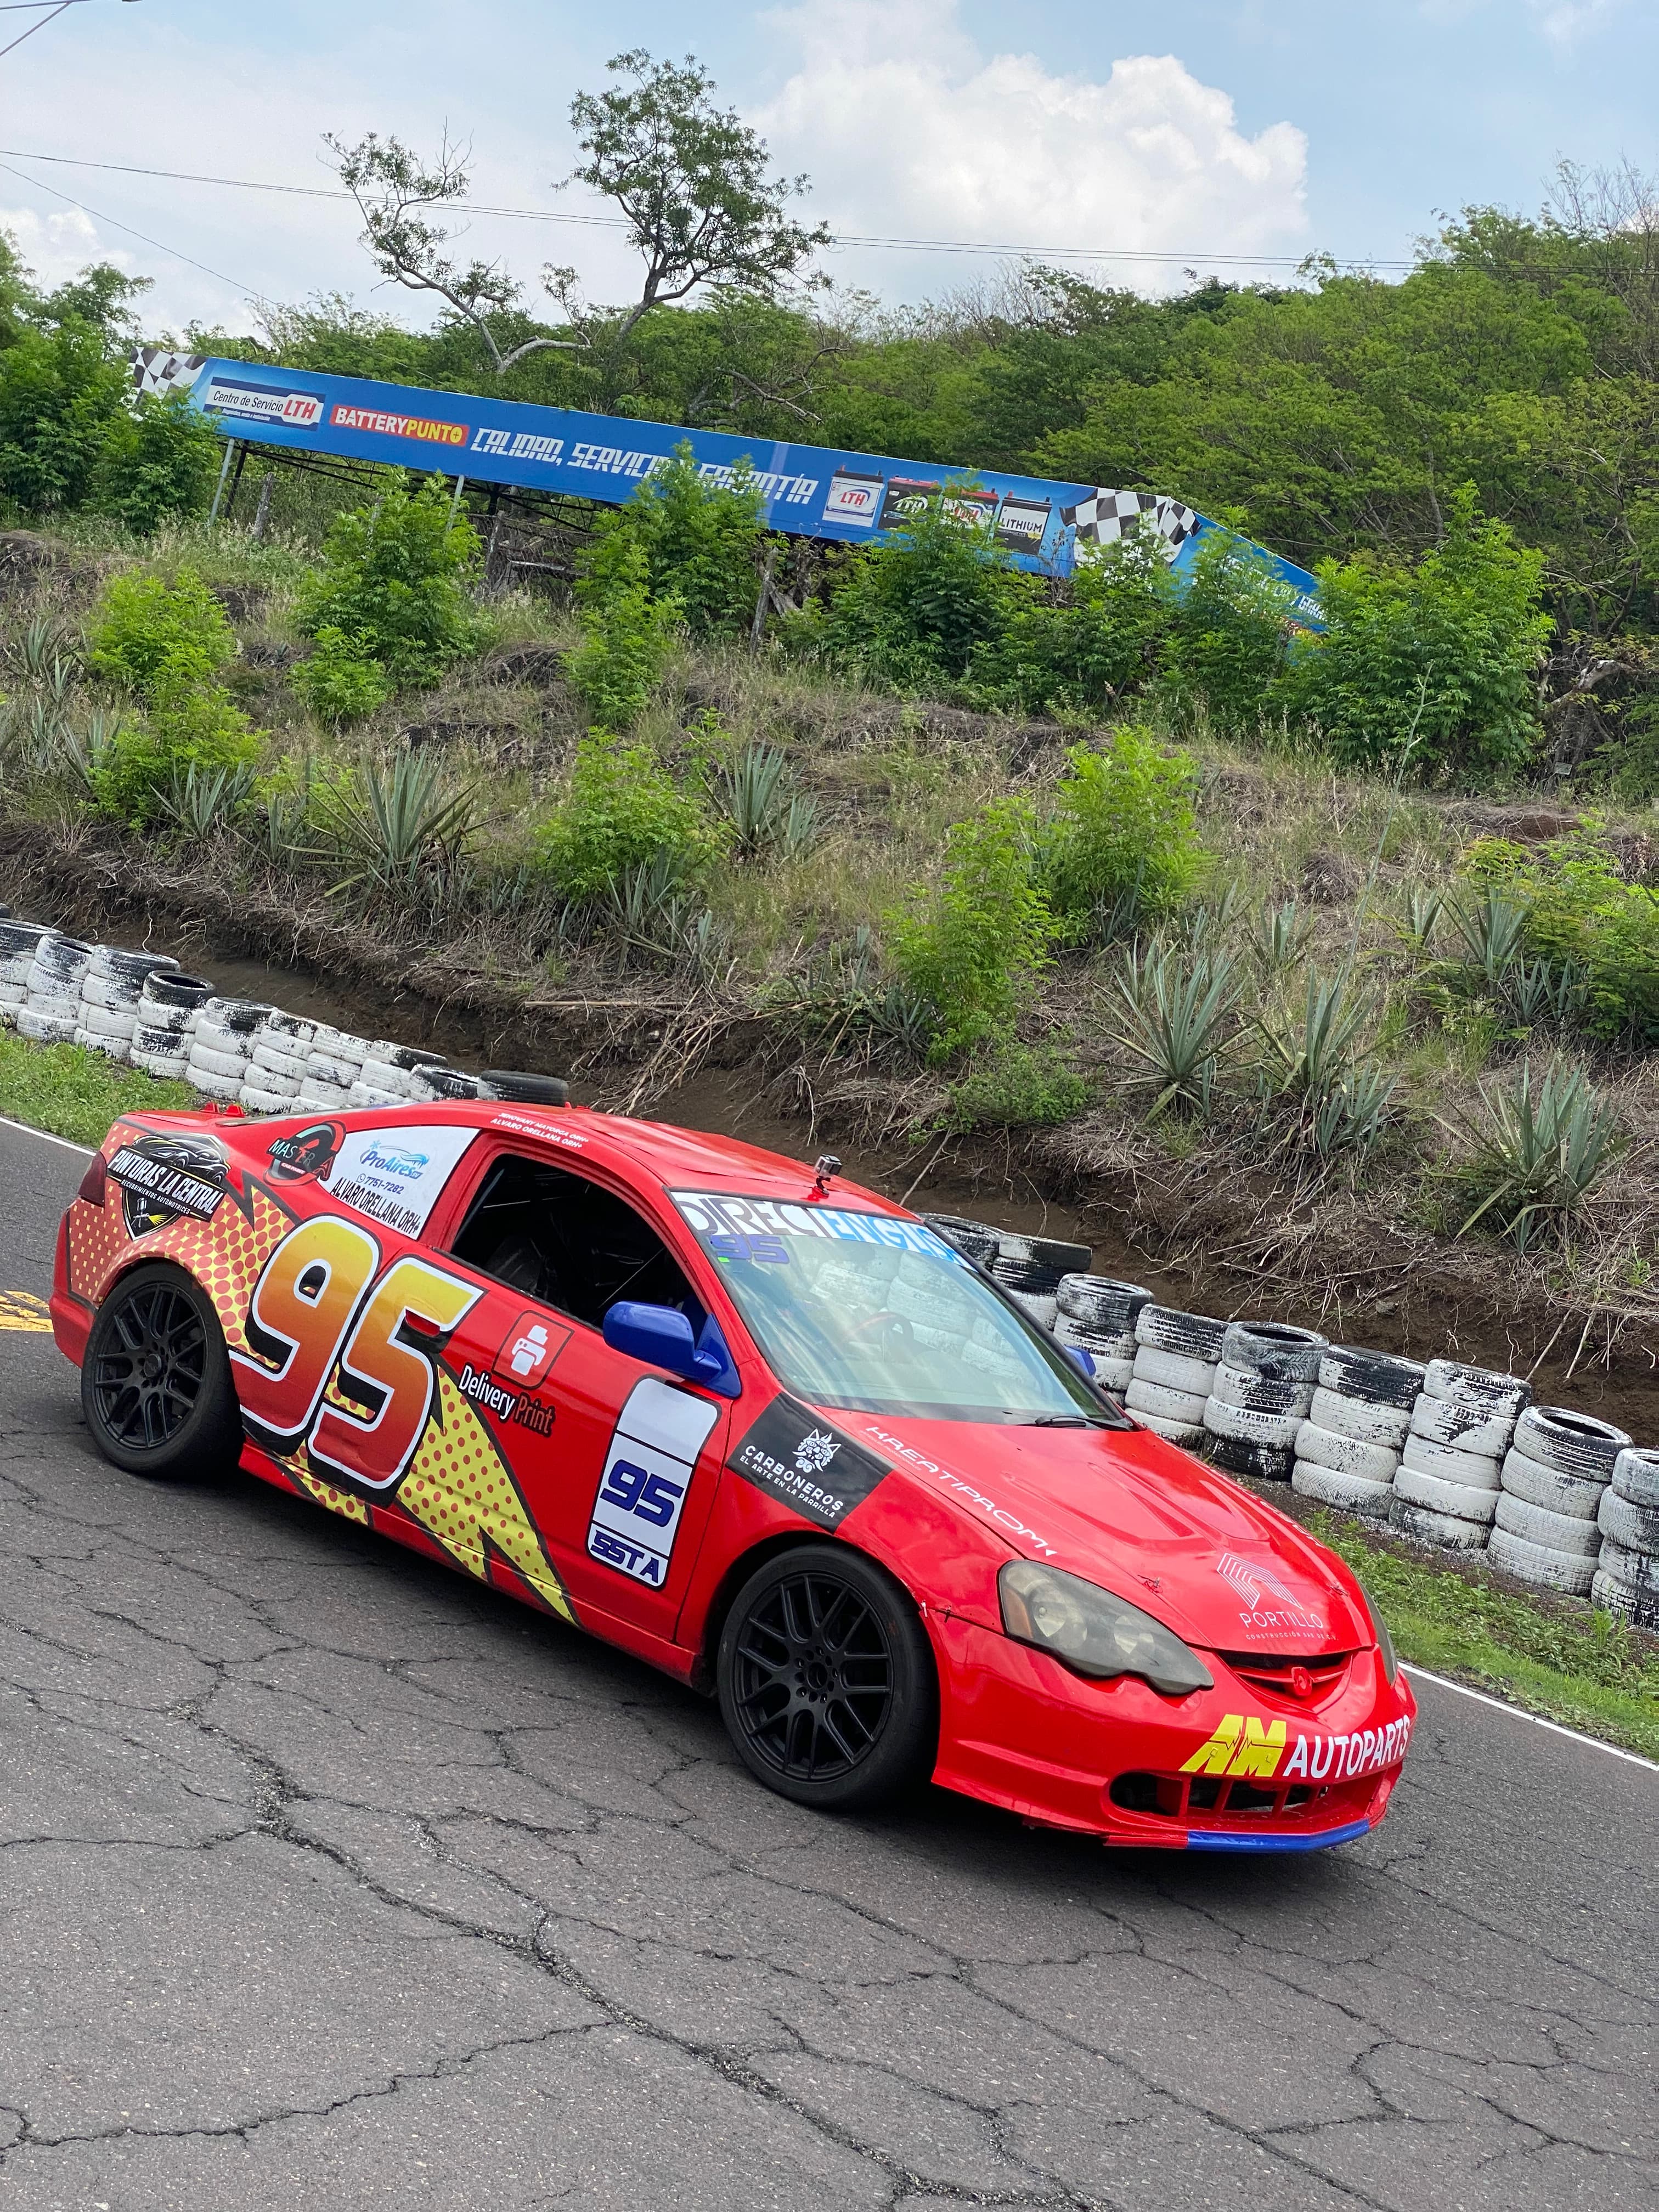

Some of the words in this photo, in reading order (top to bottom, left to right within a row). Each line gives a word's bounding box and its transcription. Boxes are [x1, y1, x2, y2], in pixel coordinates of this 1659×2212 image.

[213, 391, 239, 404] Centro
[240, 396, 251, 406] de
[252, 397, 284, 411] Servicio
[283, 399, 317, 419] LTH
[840, 492, 866, 505] LTH
[1000, 517, 1042, 533] LITHIUM
[490, 1118, 522, 1130] ALVARO
[522, 1126, 561, 1142] ORELLANA
[534, 1122, 570, 1136] MAYORGA
[361, 1150, 416, 1176] ProAires
[108, 1149, 165, 1187] PINTURAS
[157, 1171, 175, 1193] LA
[171, 1178, 223, 1214] CENTRAL
[364, 1176, 404, 1194] 7751-7282
[121, 1180, 156, 1199] RECUBRIMIENTOS
[156, 1195, 191, 1215] AUTOMOTRICES
[330, 1177, 365, 1206] ALVARO
[359, 1190, 403, 1226] ORELLANA
[710, 1234, 789, 1264] 95
[228, 1214, 487, 1491] 95
[459, 1365, 515, 1420] Delivery
[515, 1395, 553, 1434] Print
[600, 1459, 685, 1527] 95
[740, 1455, 749, 1465] EL
[751, 1464, 772, 1480] ARTE
[774, 1477, 785, 1488] EN
[786, 1485, 796, 1496] LA
[798, 1492, 836, 1518] PARRILLA
[745, 1445, 843, 1511] CARBONEROS
[1239, 1611, 1323, 1629] PORTILLO
[1246, 1630, 1301, 1640] CONSTRUCCIÓN
[1178, 1714, 1286, 1778] AM
[1283, 1714, 1410, 1778] AUTOPARTS
